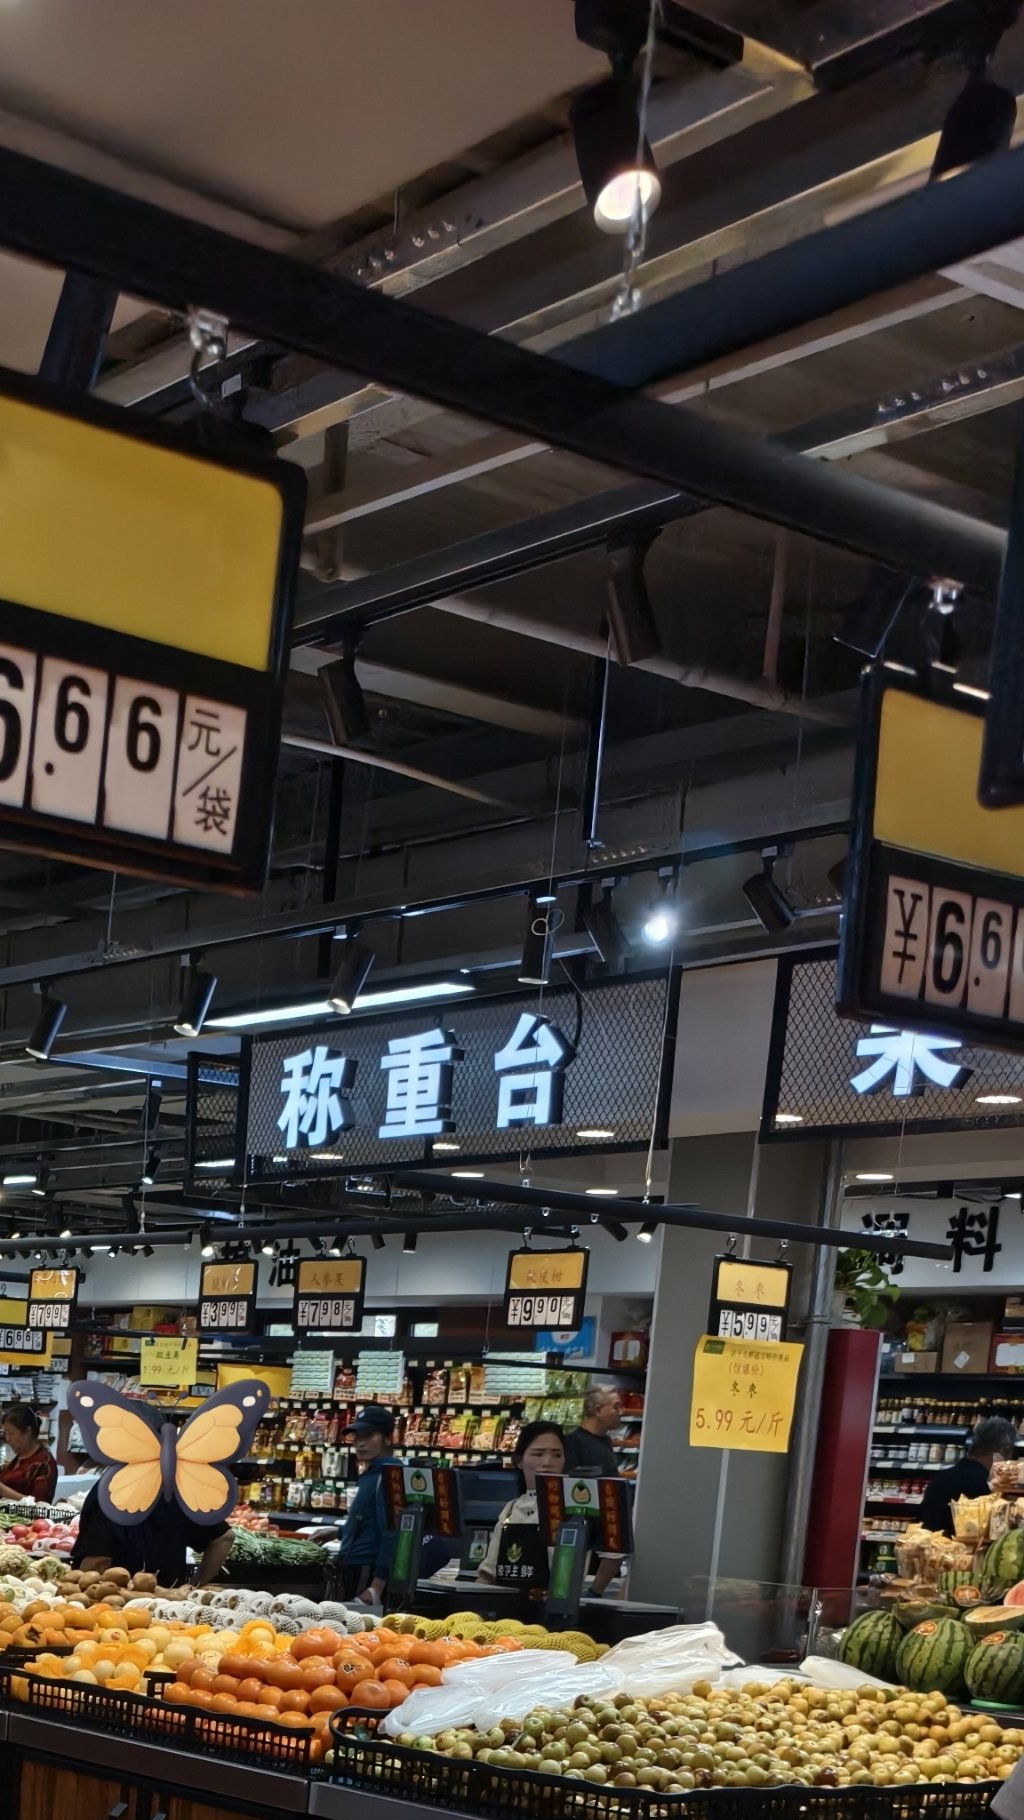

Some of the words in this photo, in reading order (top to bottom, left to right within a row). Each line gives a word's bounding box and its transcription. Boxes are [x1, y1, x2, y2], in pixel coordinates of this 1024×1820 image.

[892, 888, 1024, 995] ¥6.6
[277, 1012, 565, 1150] 称重台
[734, 1279, 765, 1299] 冬枣
[730, 1382, 758, 1398] 冬枣
[695, 1408, 733, 1432] 5.99
[739, 1411, 785, 1437] 元/斤
